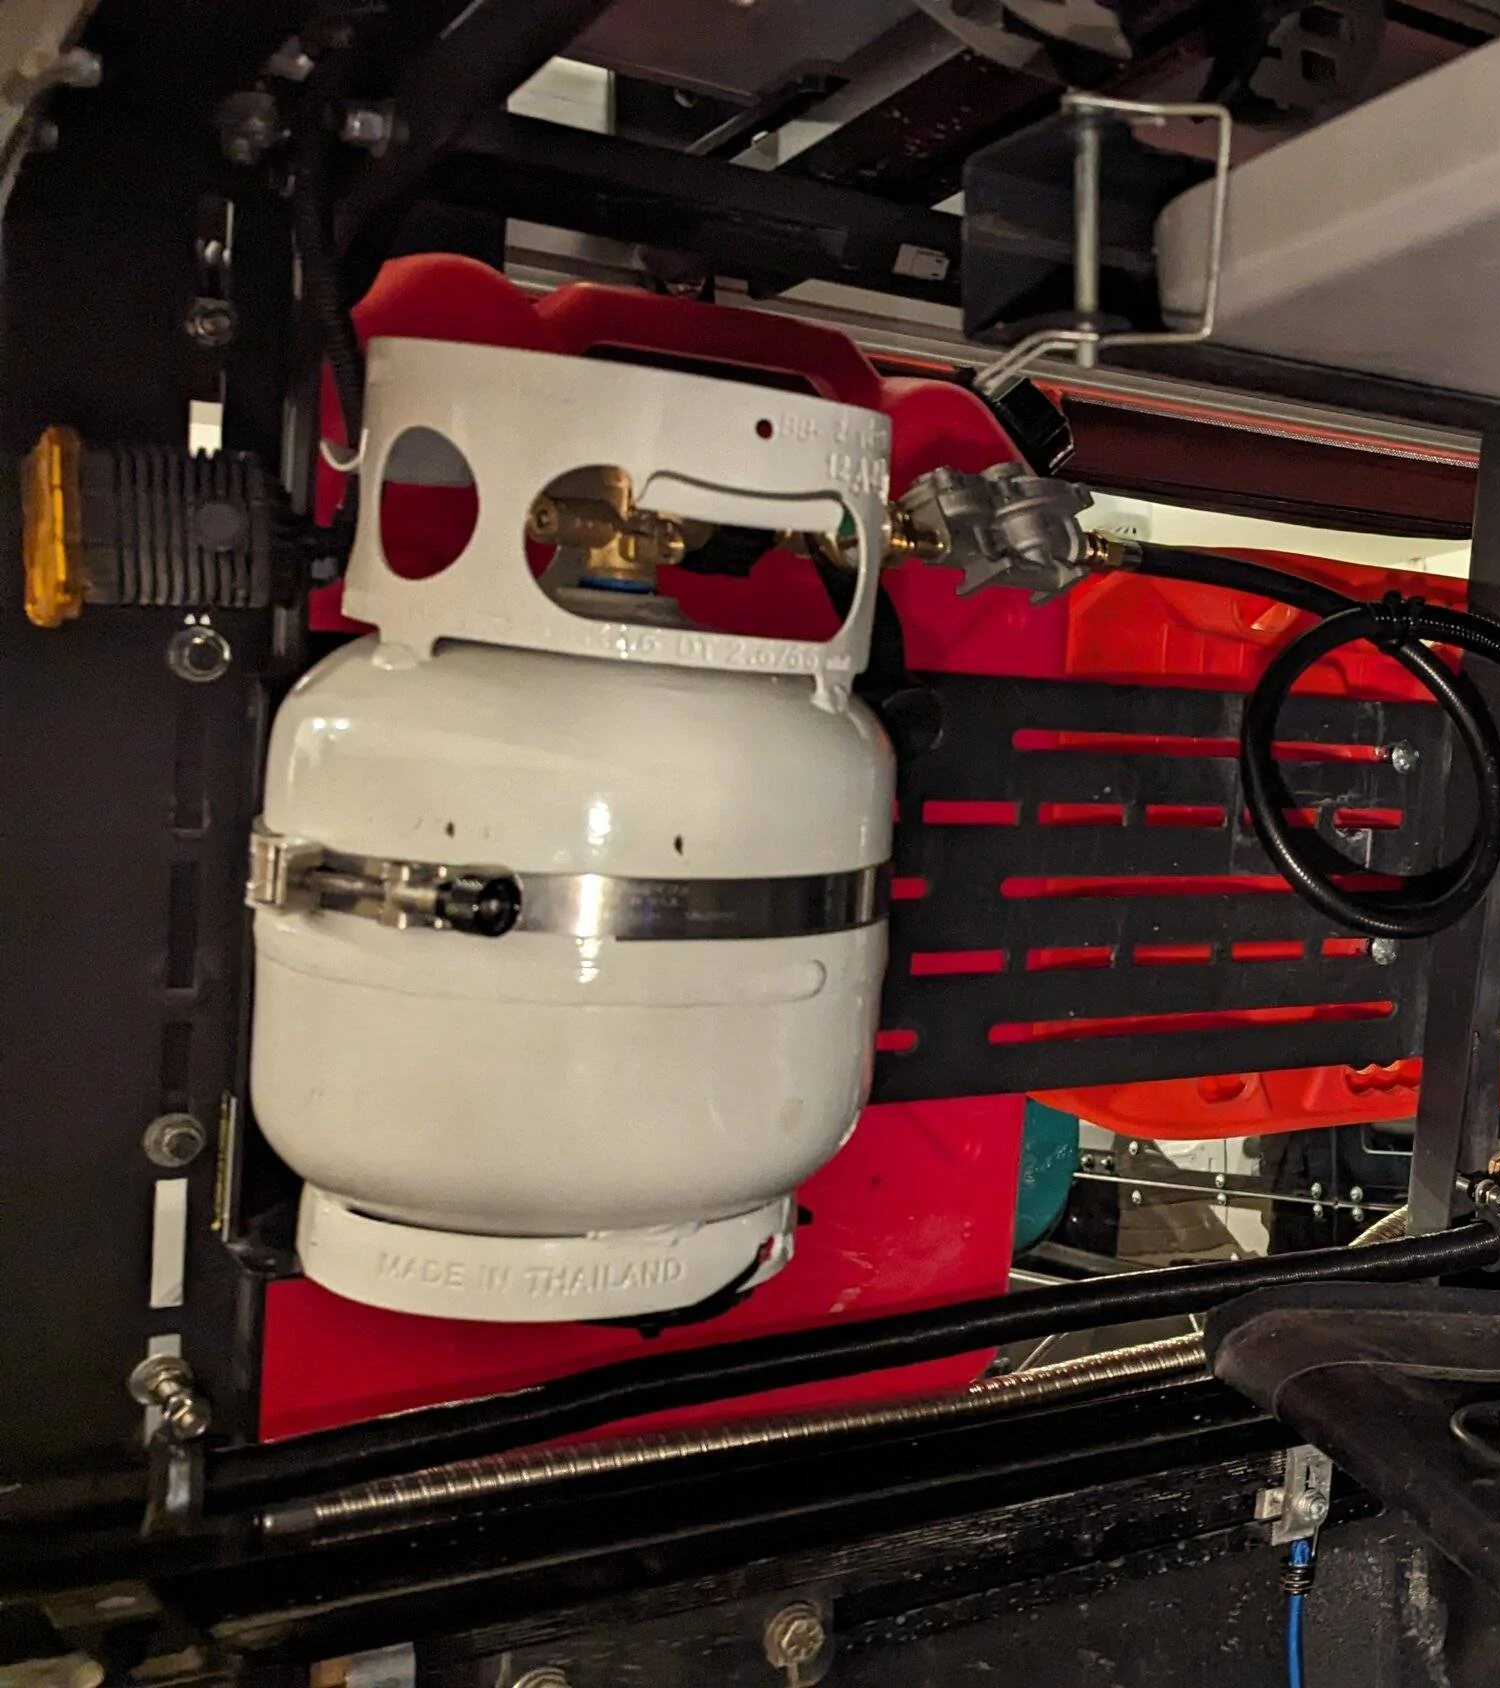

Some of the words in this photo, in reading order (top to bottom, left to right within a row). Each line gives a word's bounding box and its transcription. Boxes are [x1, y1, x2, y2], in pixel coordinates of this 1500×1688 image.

[376, 1251, 464, 1289] MADE
[480, 1262, 510, 1293] IN
[523, 1256, 684, 1298] THAILAND
